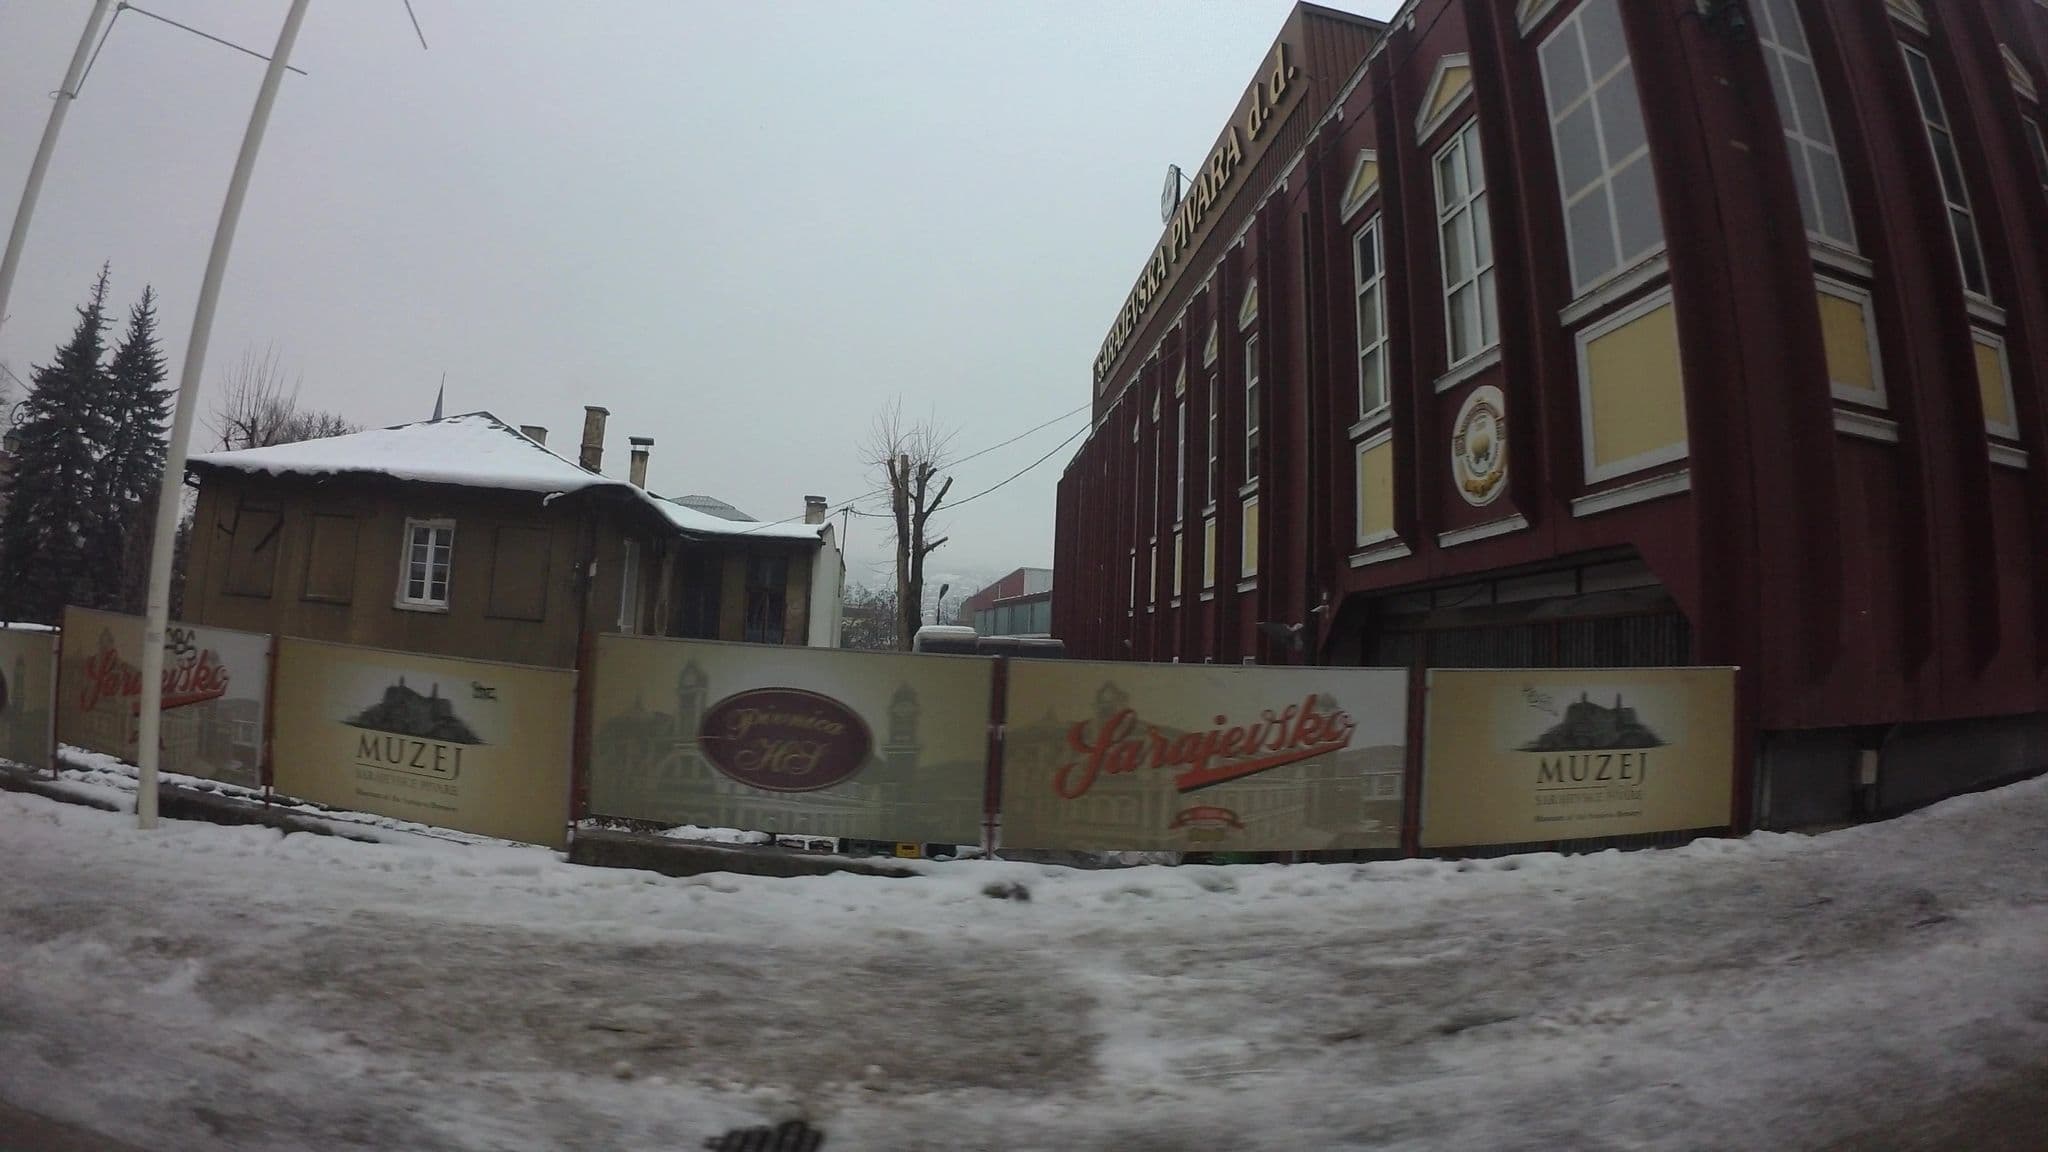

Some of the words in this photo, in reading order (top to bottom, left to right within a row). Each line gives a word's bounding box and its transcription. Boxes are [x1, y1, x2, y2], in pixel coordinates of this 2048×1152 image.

[1097, 246, 1167, 383] SARAJEVSKA
[1171, 126, 1243, 264] PIVARA
[1247, 42, 1297, 142] d.d.
[356, 733, 464, 780] MUZEJ
[1536, 753, 1649, 787] MUZEJ
